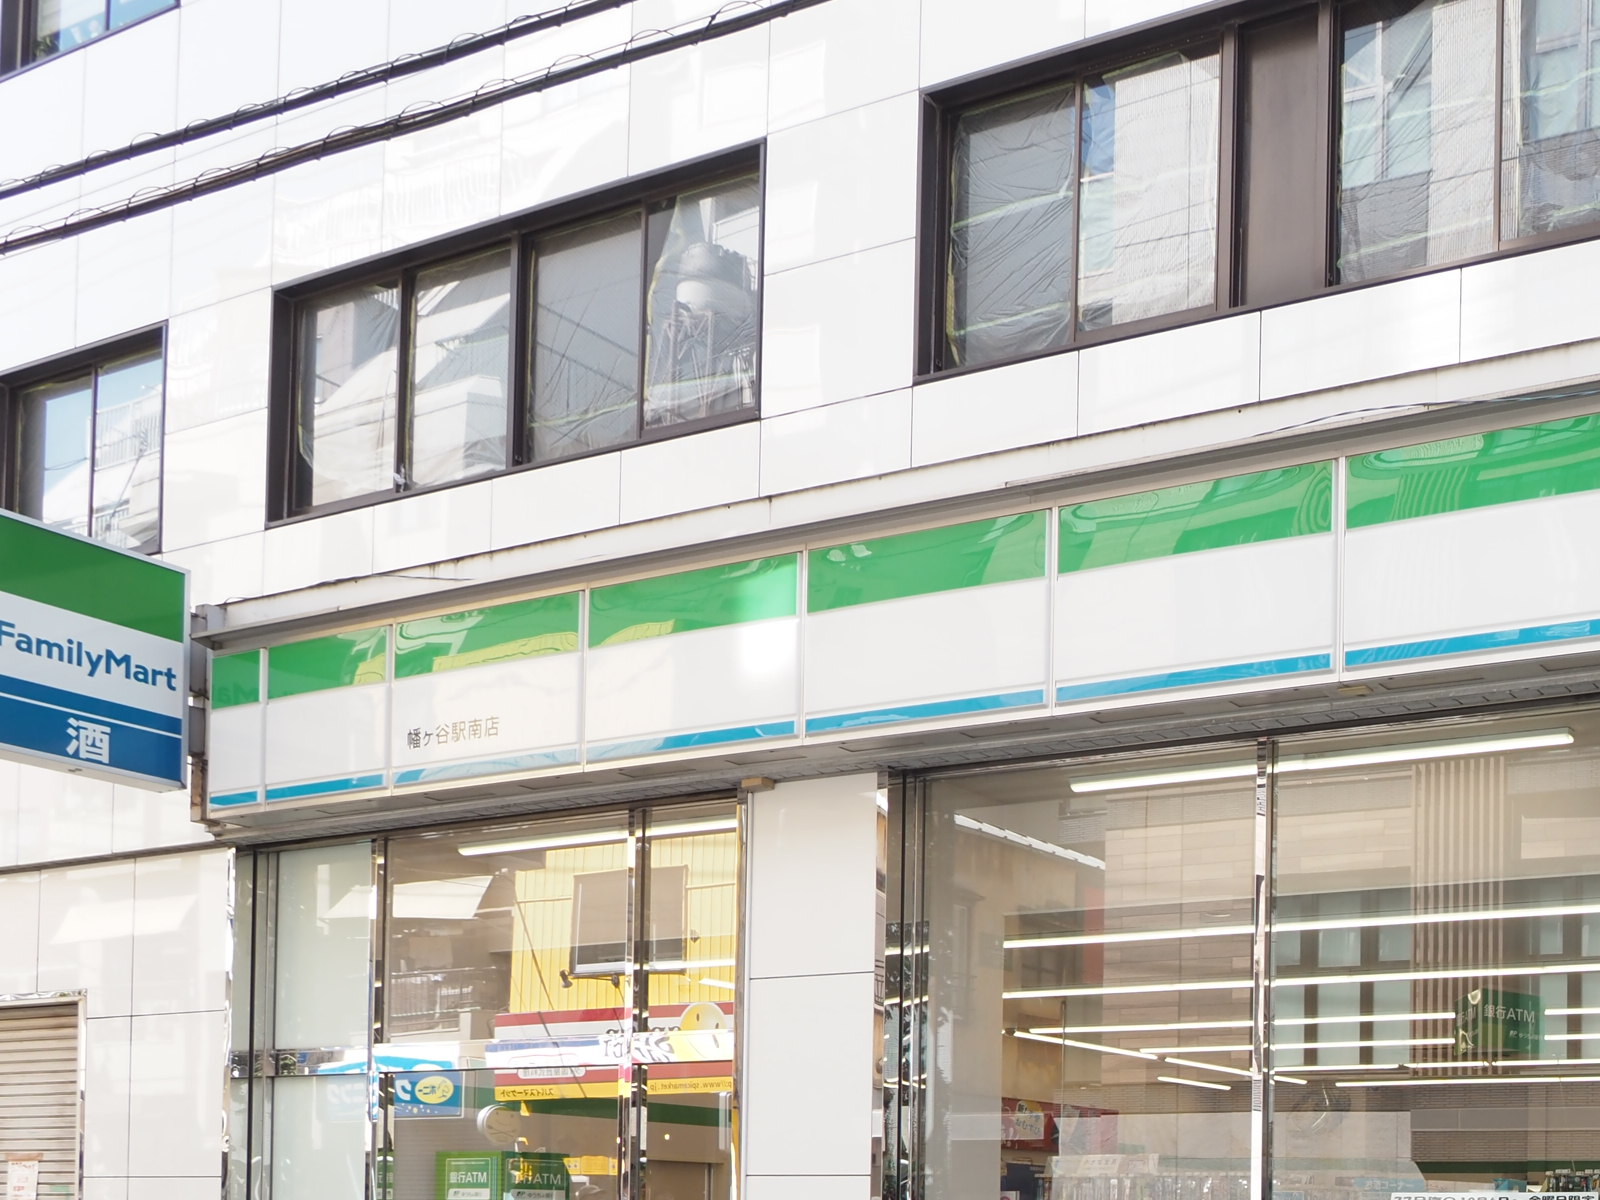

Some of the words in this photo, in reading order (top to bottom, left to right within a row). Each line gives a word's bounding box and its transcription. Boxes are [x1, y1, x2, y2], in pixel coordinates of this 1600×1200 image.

[0, 620, 176, 691] FamilyMart
[66, 717, 111, 763] 酒
[407, 716, 499, 750] 幡ヶ谷駅南店
[1484, 1004, 1535, 1023] 銀行ATM
